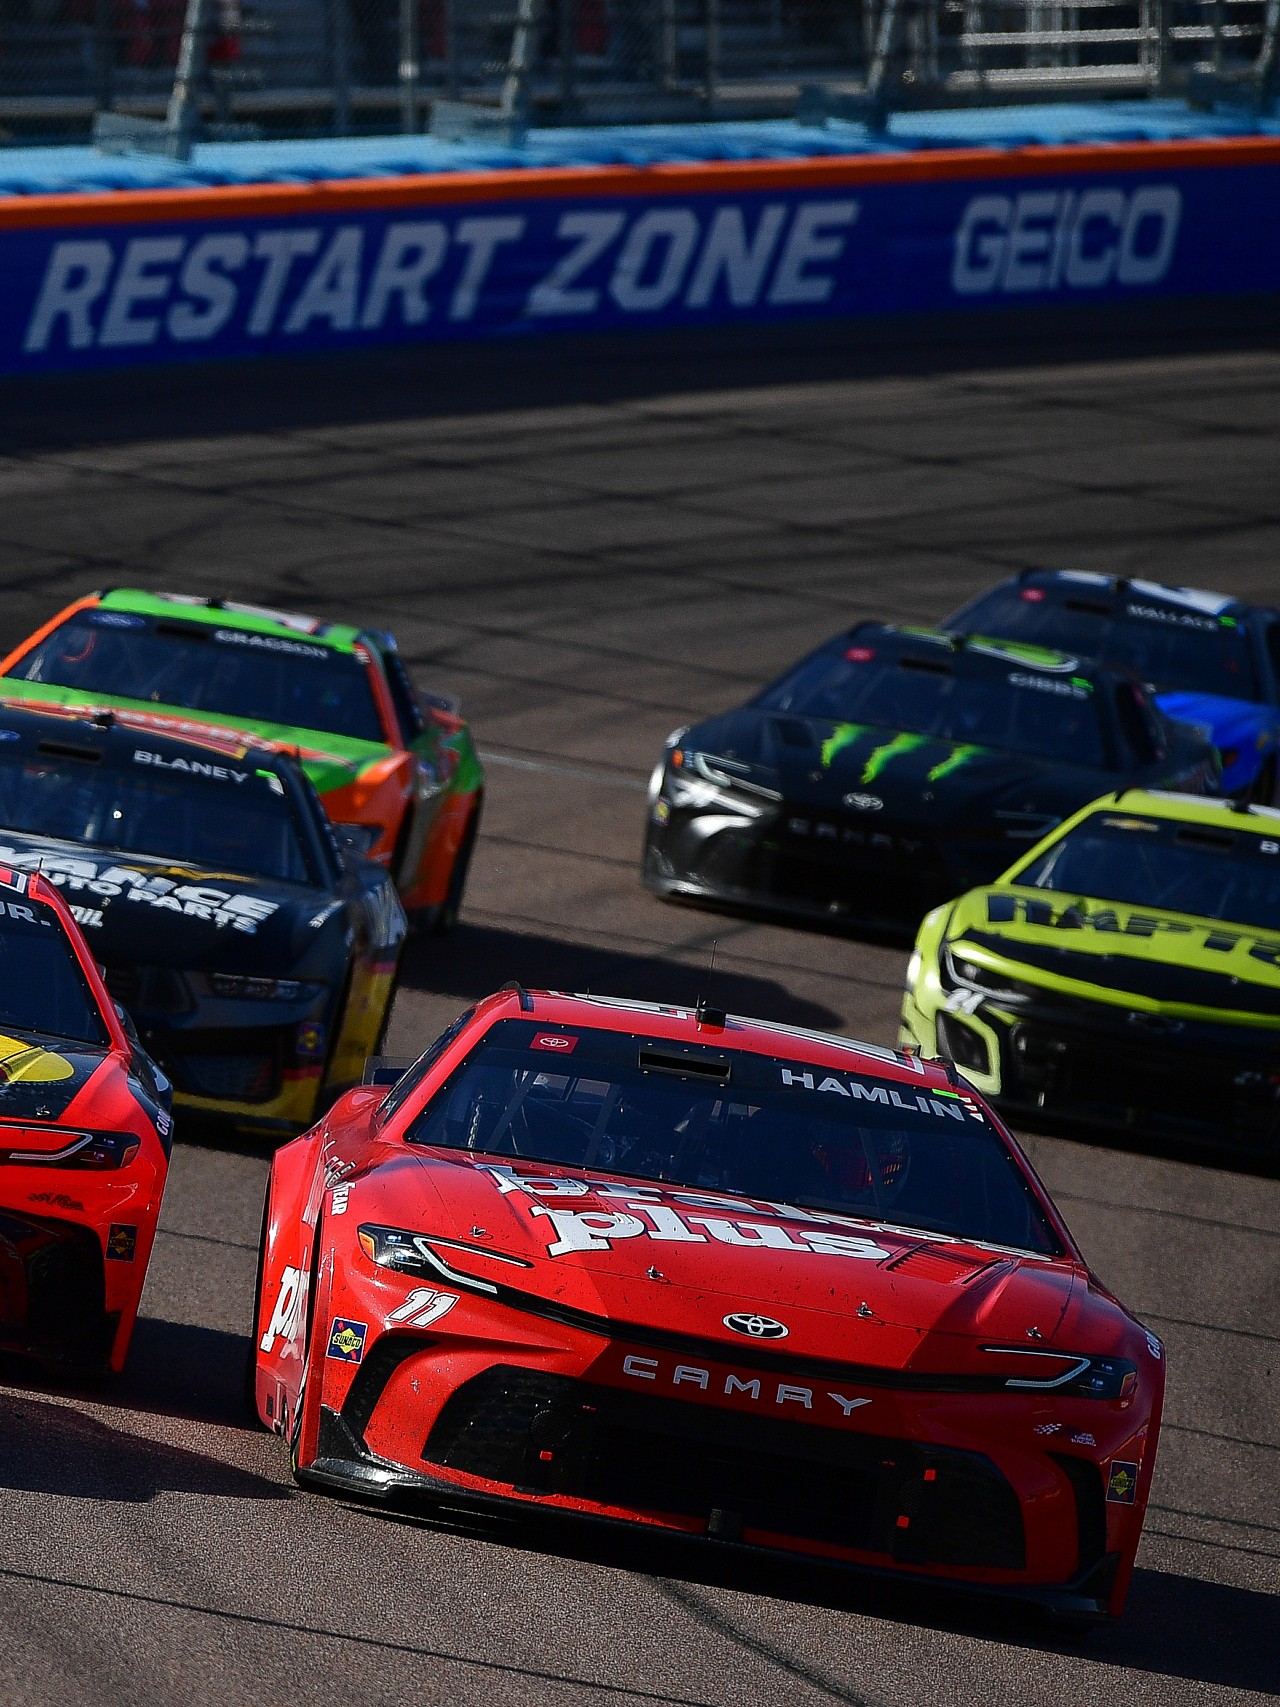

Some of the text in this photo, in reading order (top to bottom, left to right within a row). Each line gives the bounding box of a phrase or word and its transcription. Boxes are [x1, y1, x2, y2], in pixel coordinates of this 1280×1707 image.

[951, 187, 1180, 292] GEICO
[24, 201, 857, 352] RESTART ZONE
[134, 749, 249, 784] BLANEY
[40, 869, 261, 935] UTO PARTS
[780, 1068, 966, 1122] HAMLIN
[529, 1202, 893, 1259] plus
[385, 1286, 461, 1329] 11
[332, 1333, 363, 1349] SUNOCO
[622, 1354, 873, 1417] CAMRY
